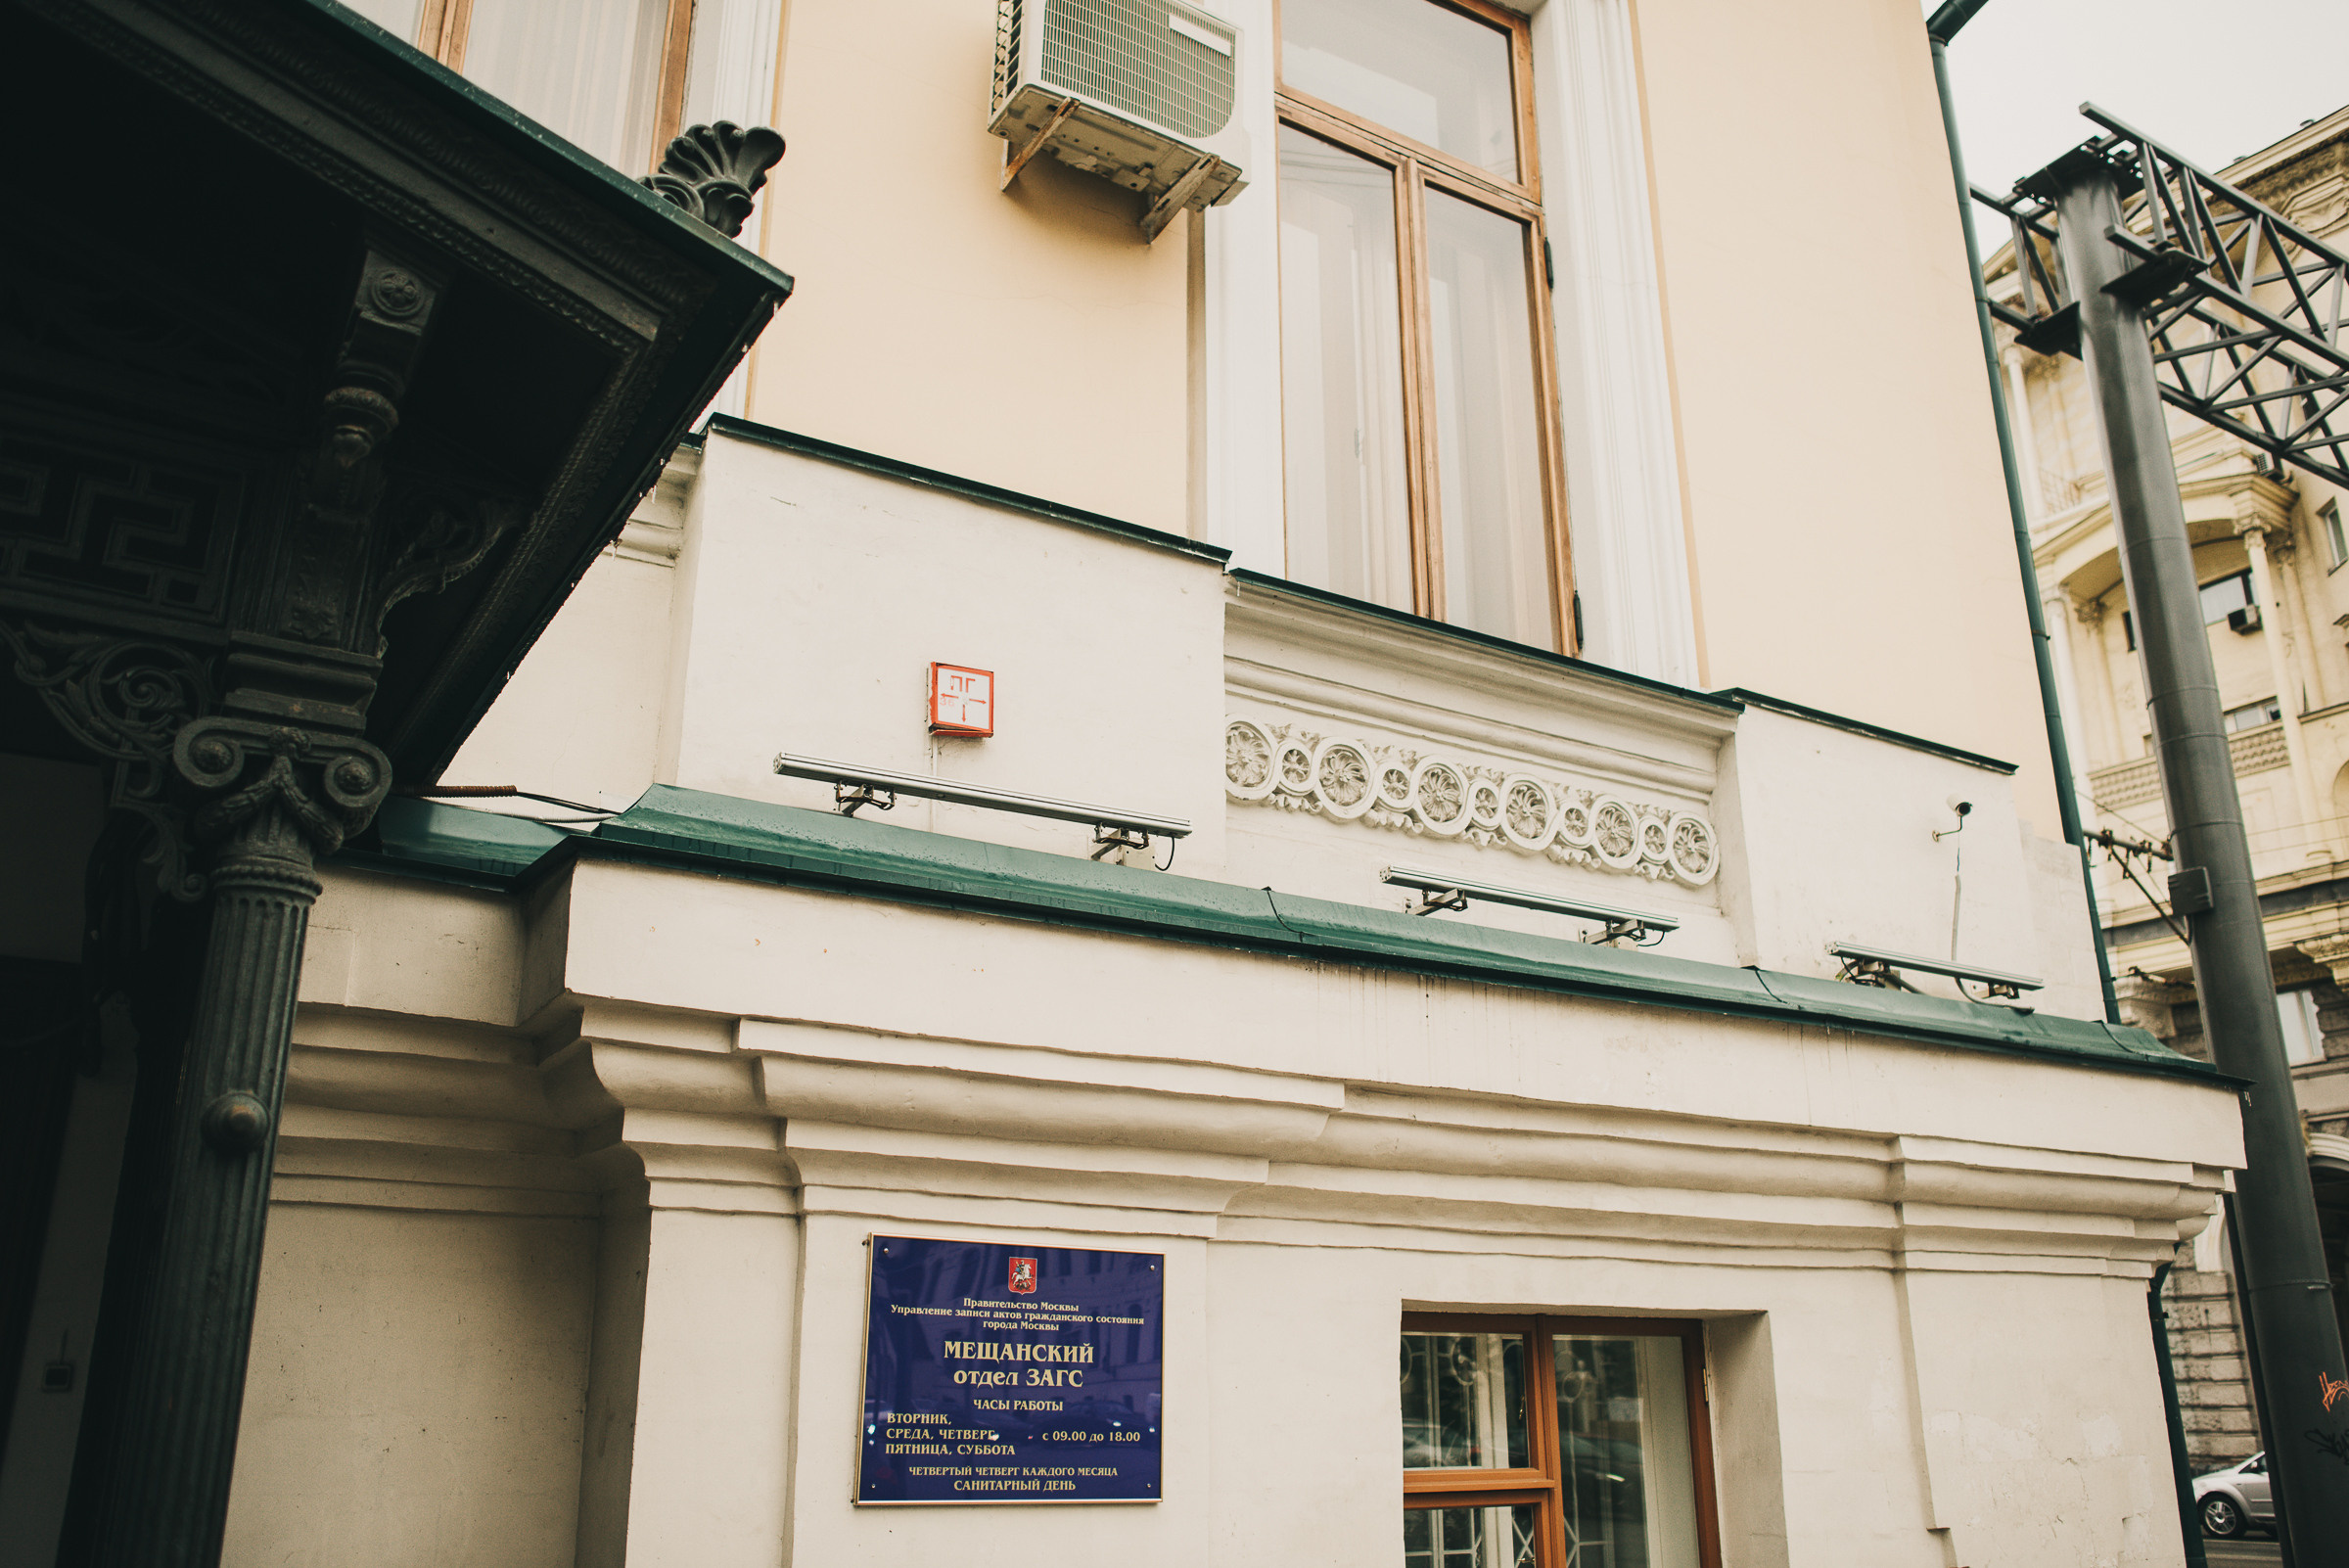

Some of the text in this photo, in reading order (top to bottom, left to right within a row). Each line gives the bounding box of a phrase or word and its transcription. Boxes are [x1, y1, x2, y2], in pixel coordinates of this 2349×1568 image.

[963, 1298, 1079, 1312] Правительство Москвы
[891, 1304, 1144, 1324] Управление записи актов гражданского состояния
[983, 1320, 1059, 1331] города Москвы
[944, 1340, 1094, 1364] МЕЩАНСКИЙ
[953, 1368, 1083, 1390] отдел ЗАГС
[973, 1399, 1064, 1411] ЧАСЫ РАБОТЫ
[887, 1412, 952, 1425] ВТОРНИК,
[886, 1428, 934, 1441] СРЕДА,
[1042, 1430, 1141, 1444] с 09.00 до 18.00
[885, 1444, 1016, 1456] ПЯТНИЦА, СУББОТА
[908, 1465, 1119, 1478] ЧЕТВЕРТЫЙ ЧЕТВЕРГ КАЖДОГО МЕСЯЦА
[953, 1478, 1077, 1493] САНИТАРНЫЙ ДЕНЬ
